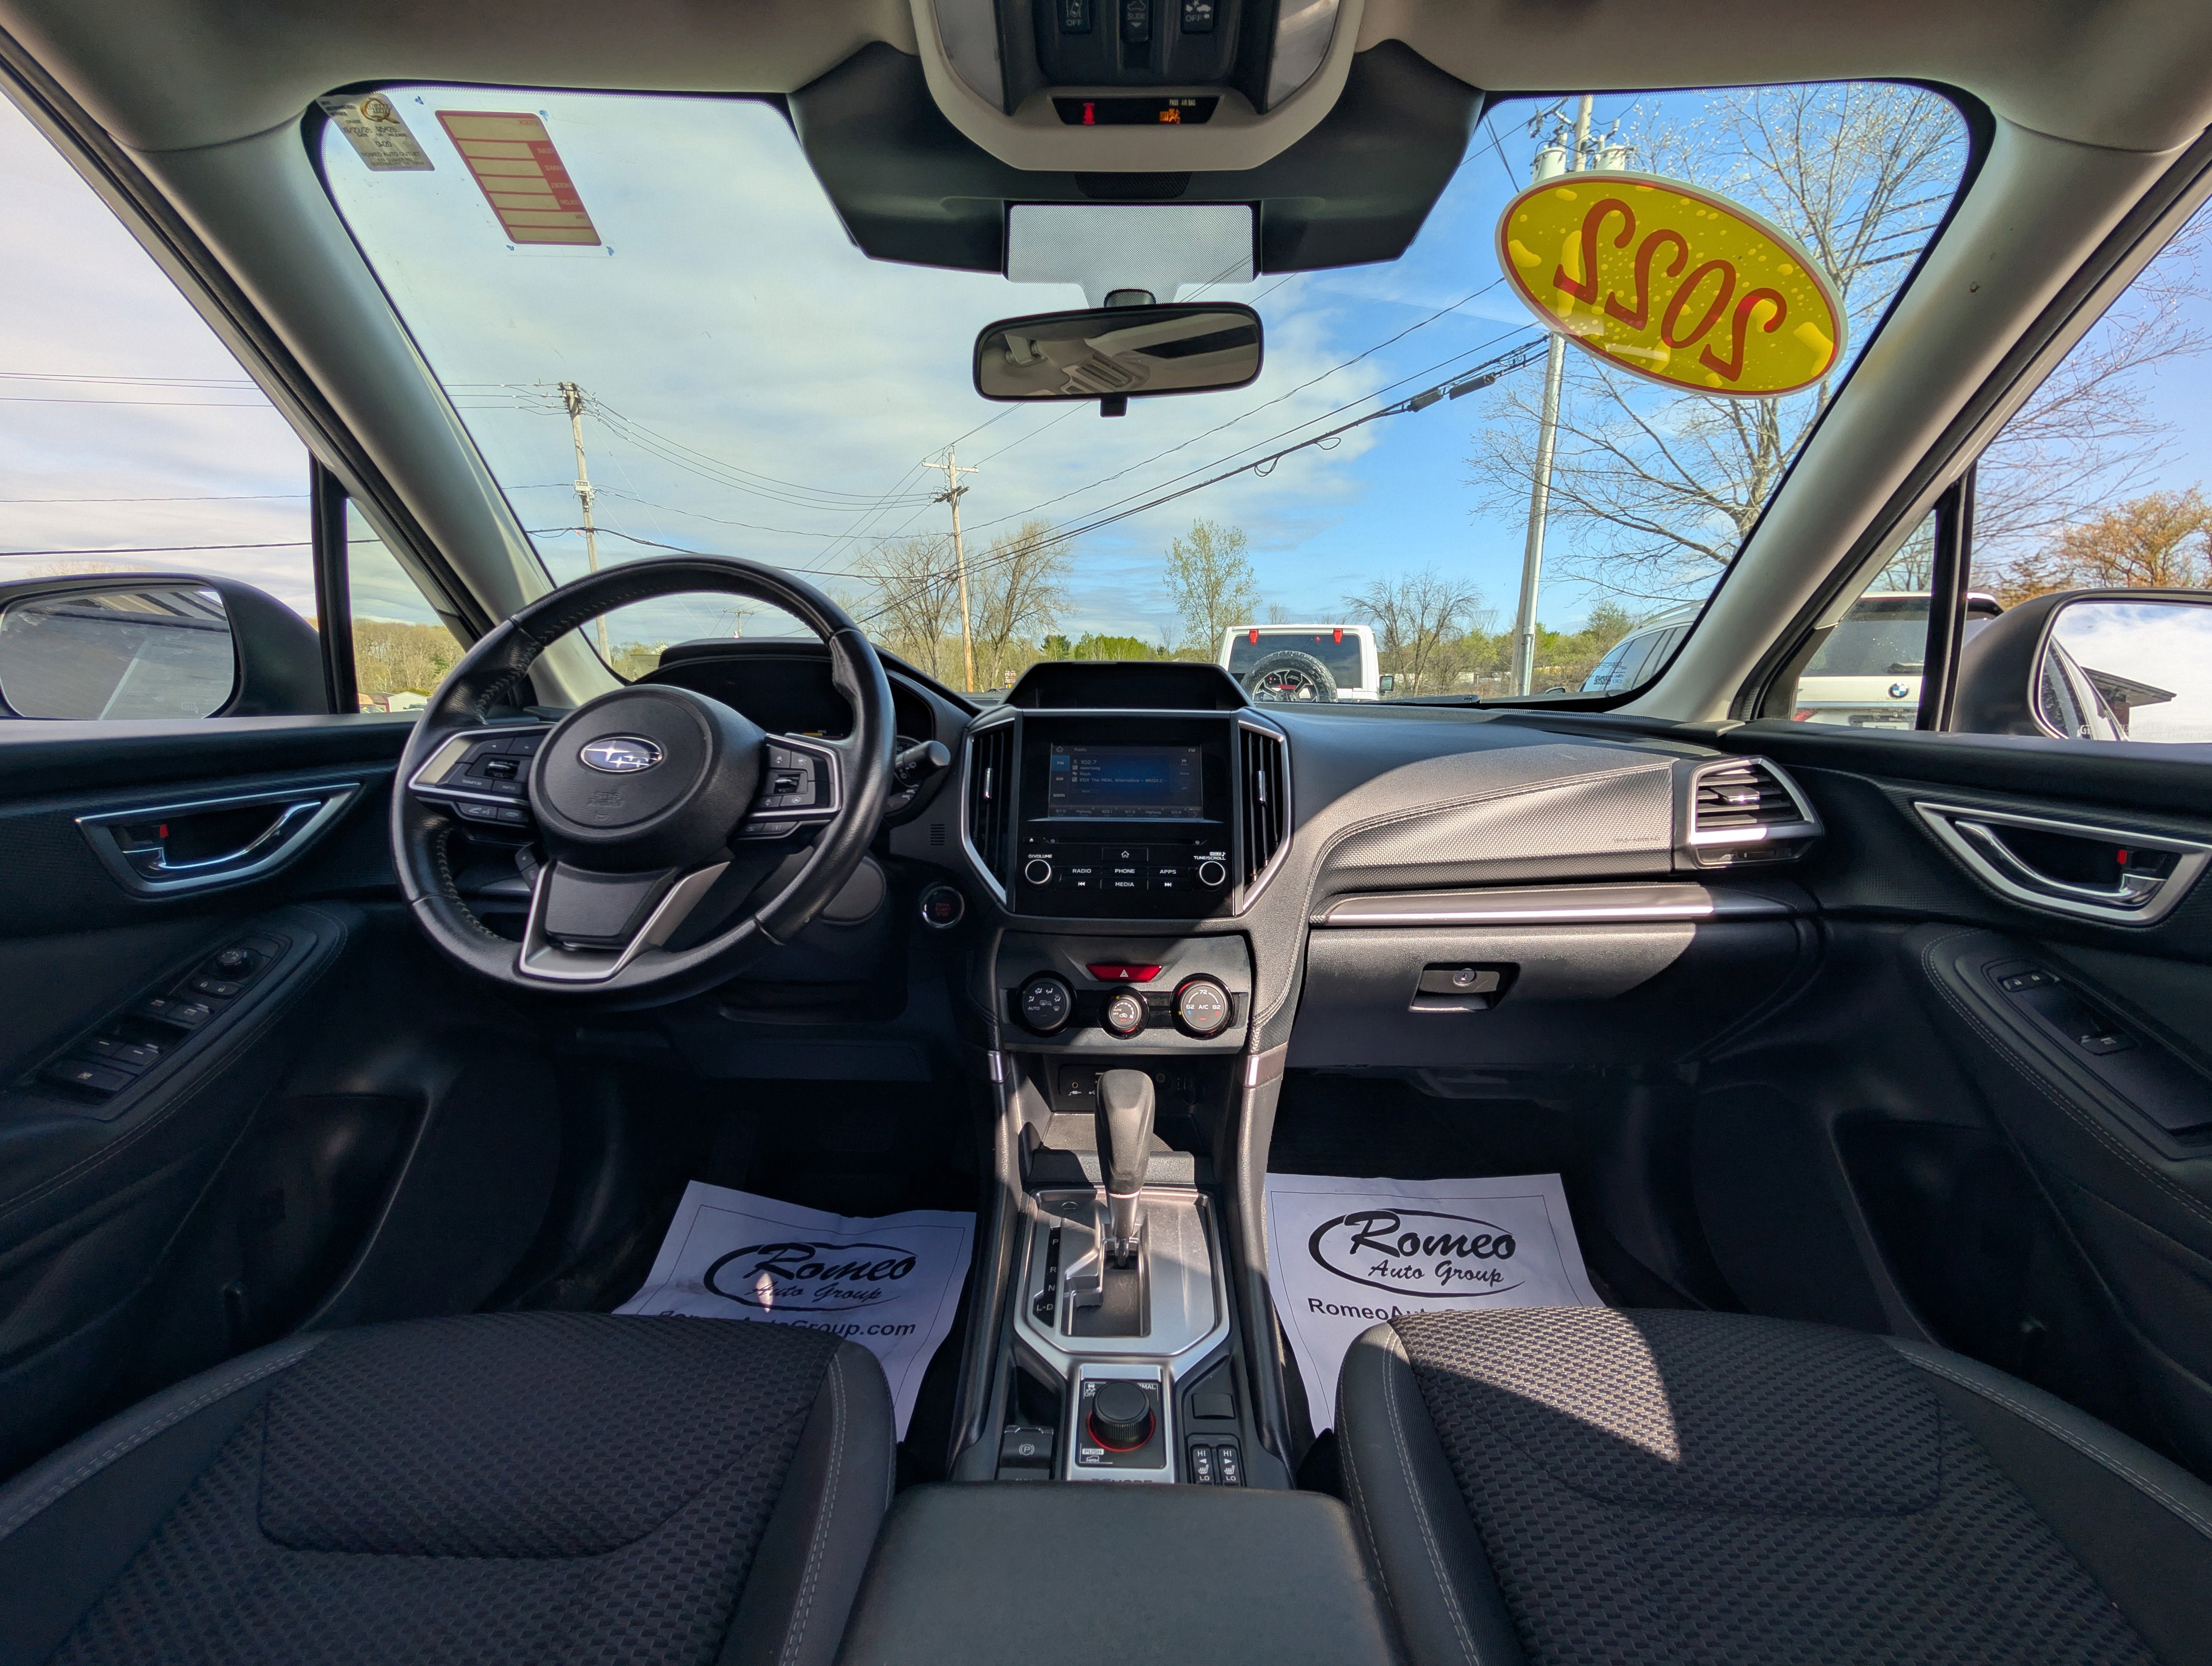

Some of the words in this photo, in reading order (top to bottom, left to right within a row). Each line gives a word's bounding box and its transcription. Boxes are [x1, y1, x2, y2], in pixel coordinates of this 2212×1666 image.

[1344, 1211, 1516, 1260] Romeo
[743, 1242, 917, 1281] Romeo
[1368, 1260, 1425, 1279] Auto
[1434, 1260, 1505, 1287] Group
[745, 1282, 803, 1297] Auto
[811, 1283, 883, 1303] Group
